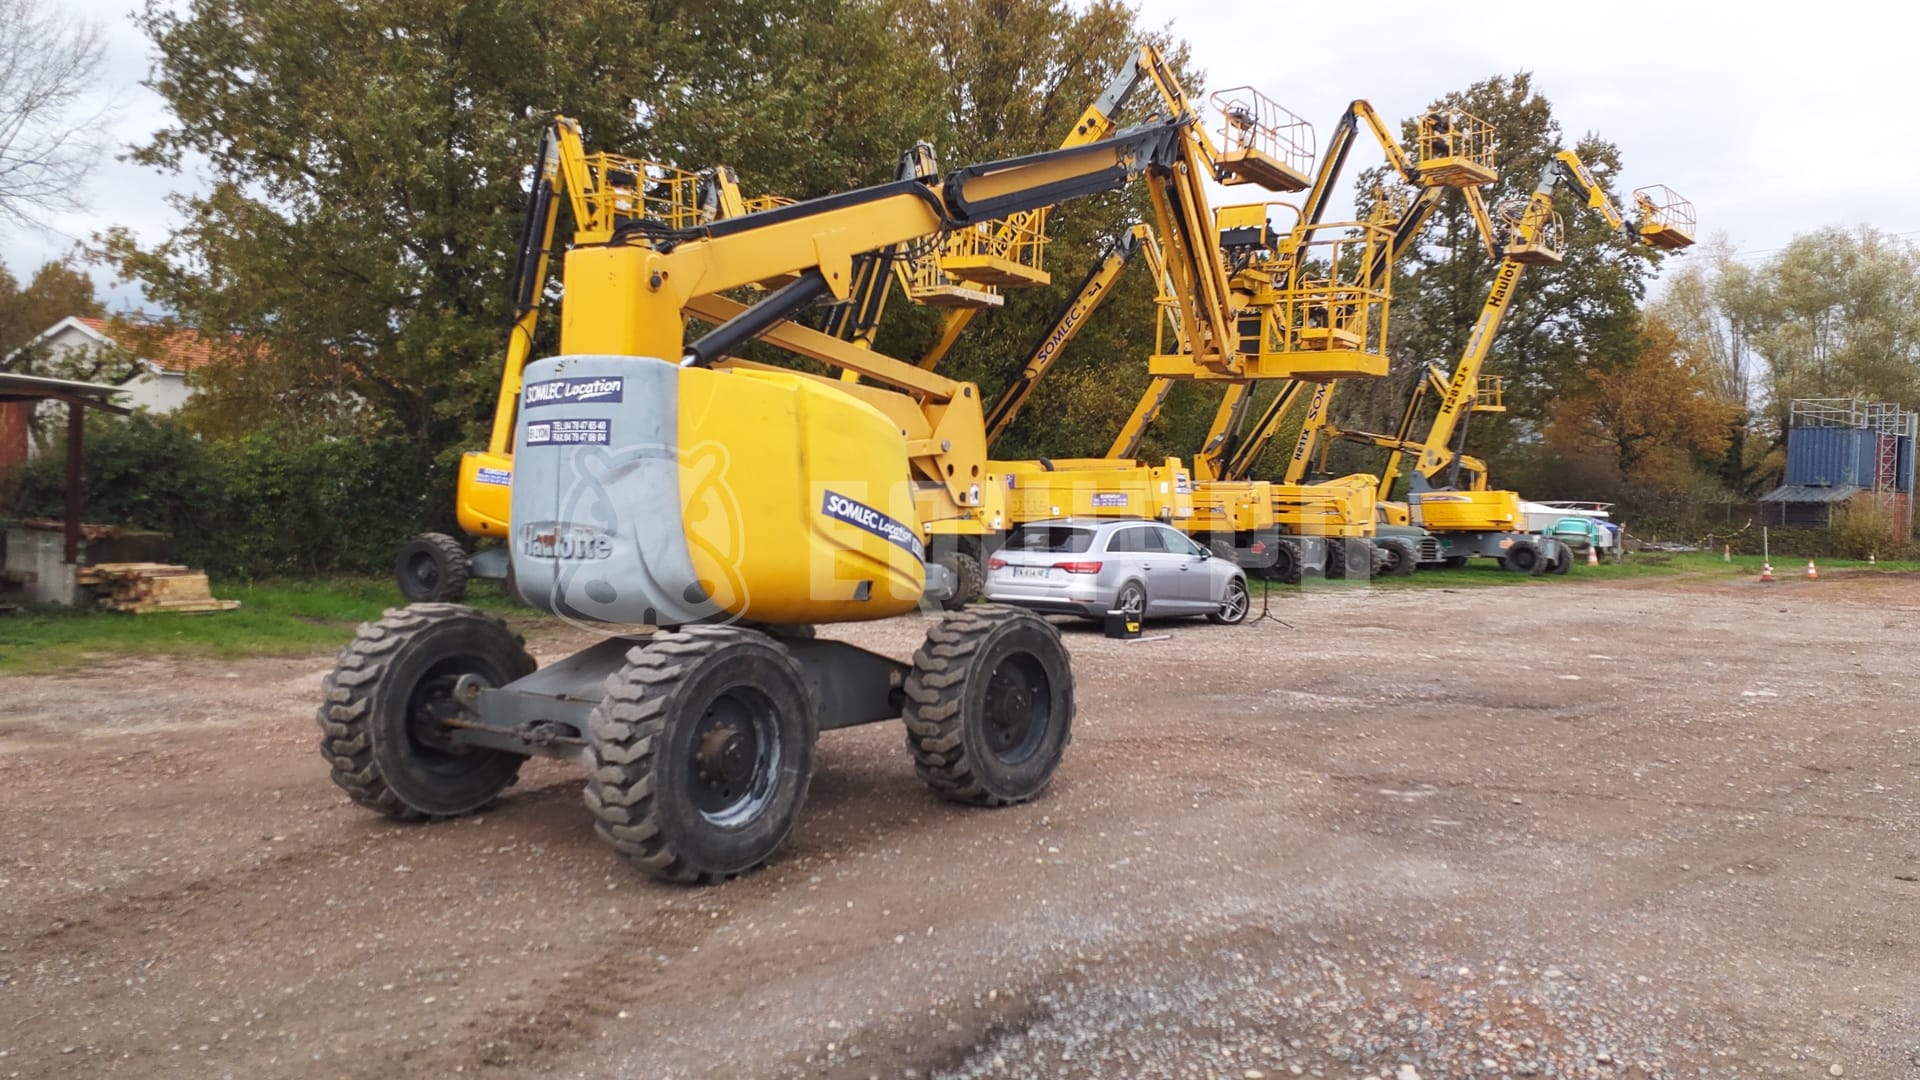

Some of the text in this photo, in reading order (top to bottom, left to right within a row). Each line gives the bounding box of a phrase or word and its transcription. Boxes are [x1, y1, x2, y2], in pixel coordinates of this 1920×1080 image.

[1488, 260, 1517, 308] Haulot
[1038, 307, 1081, 365] SOMLEC
[526, 379, 621, 403] SOMLEC Location
[1294, 429, 1310, 461] H21TX
[826, 495, 912, 543] SOMLEC Location
